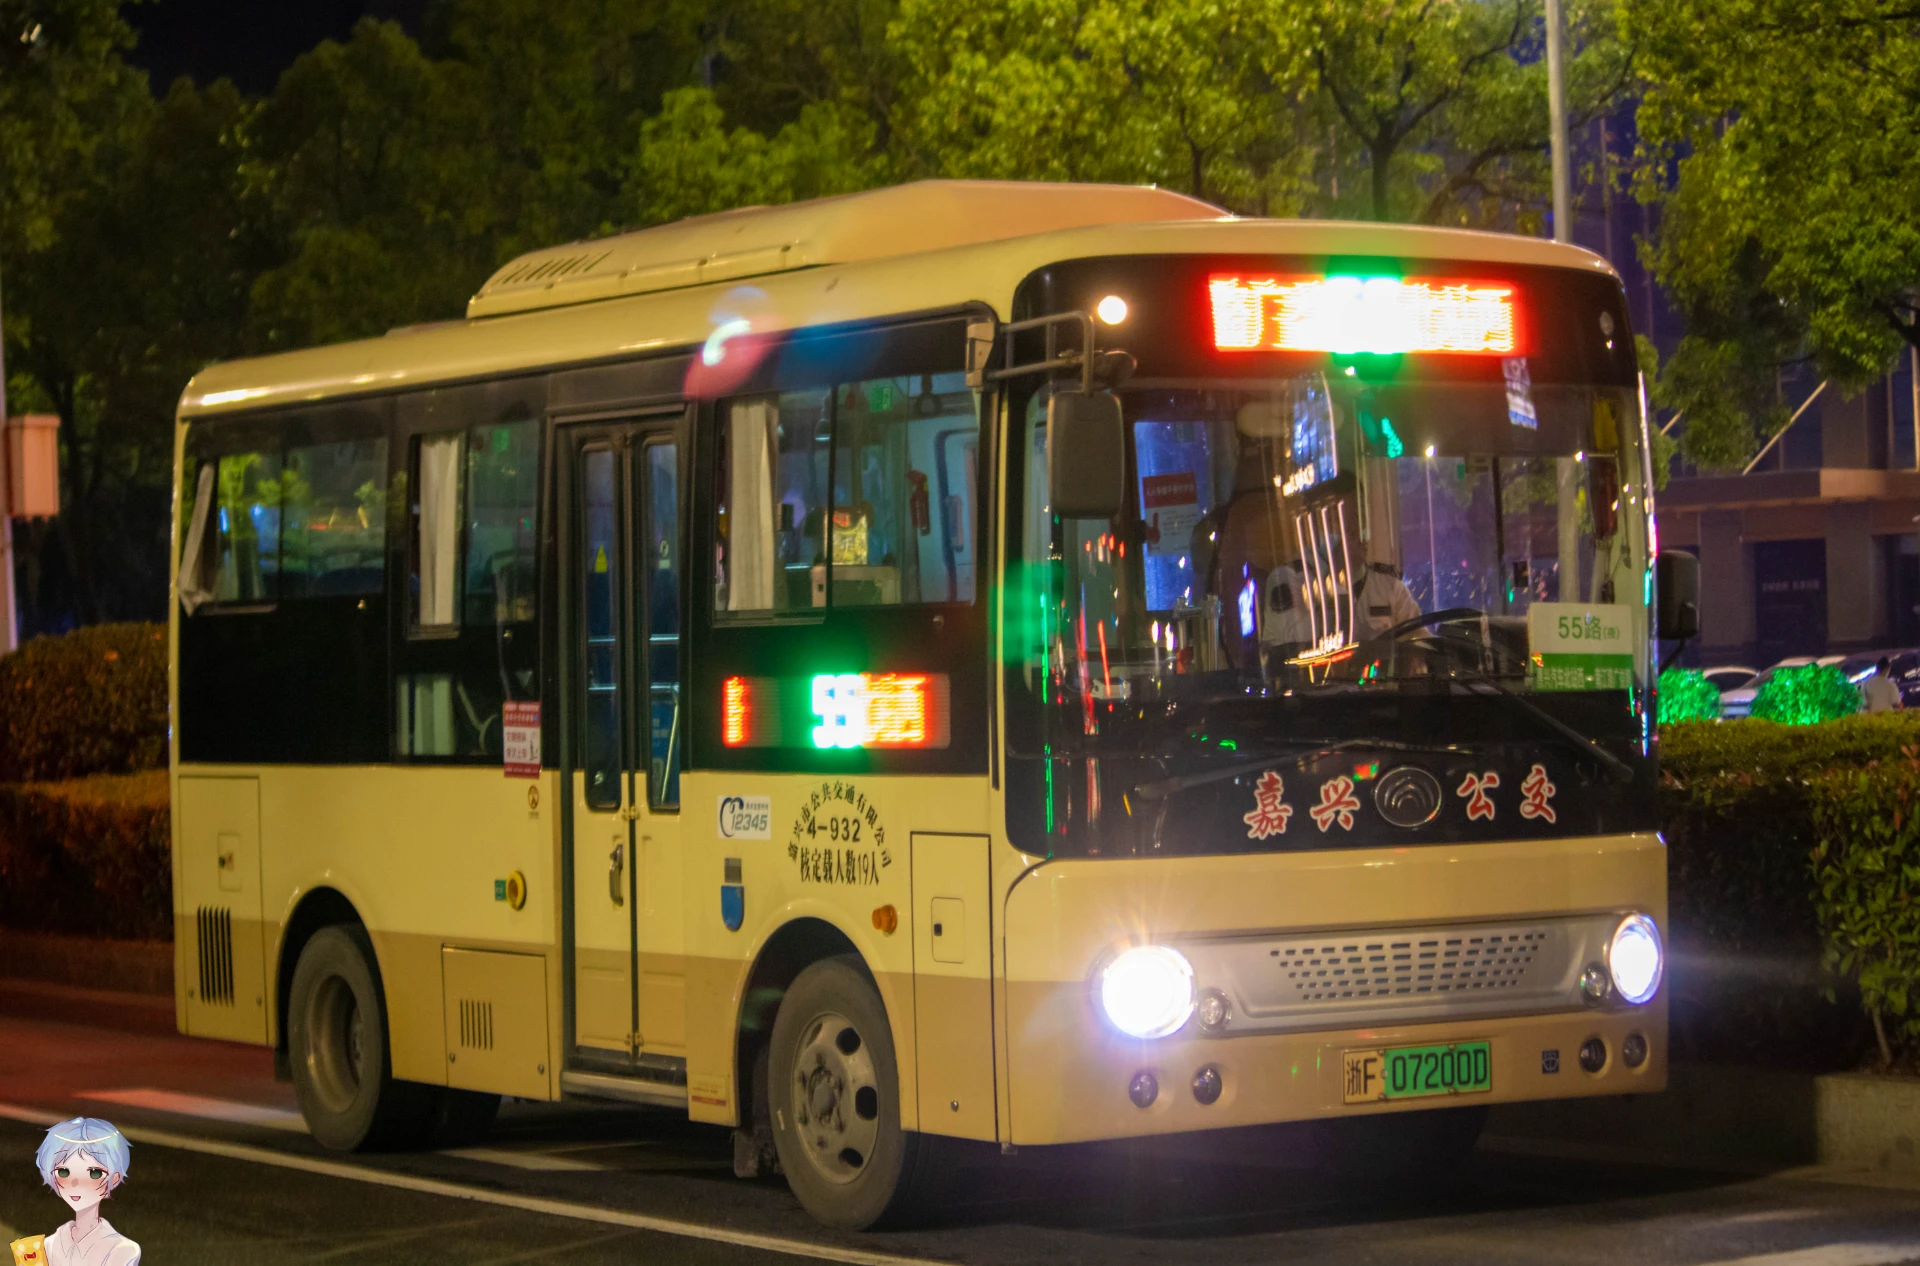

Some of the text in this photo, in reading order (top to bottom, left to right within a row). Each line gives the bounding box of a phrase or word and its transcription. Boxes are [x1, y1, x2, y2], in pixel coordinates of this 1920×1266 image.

[1243, 764, 1557, 841] 嘉兴 公交
[732, 813, 768, 832] 12345
[807, 815, 861, 843] 4-932
[800, 847, 880, 886] 核定载人数19人
[1347, 1049, 1488, 1096] 浙F 07200D
